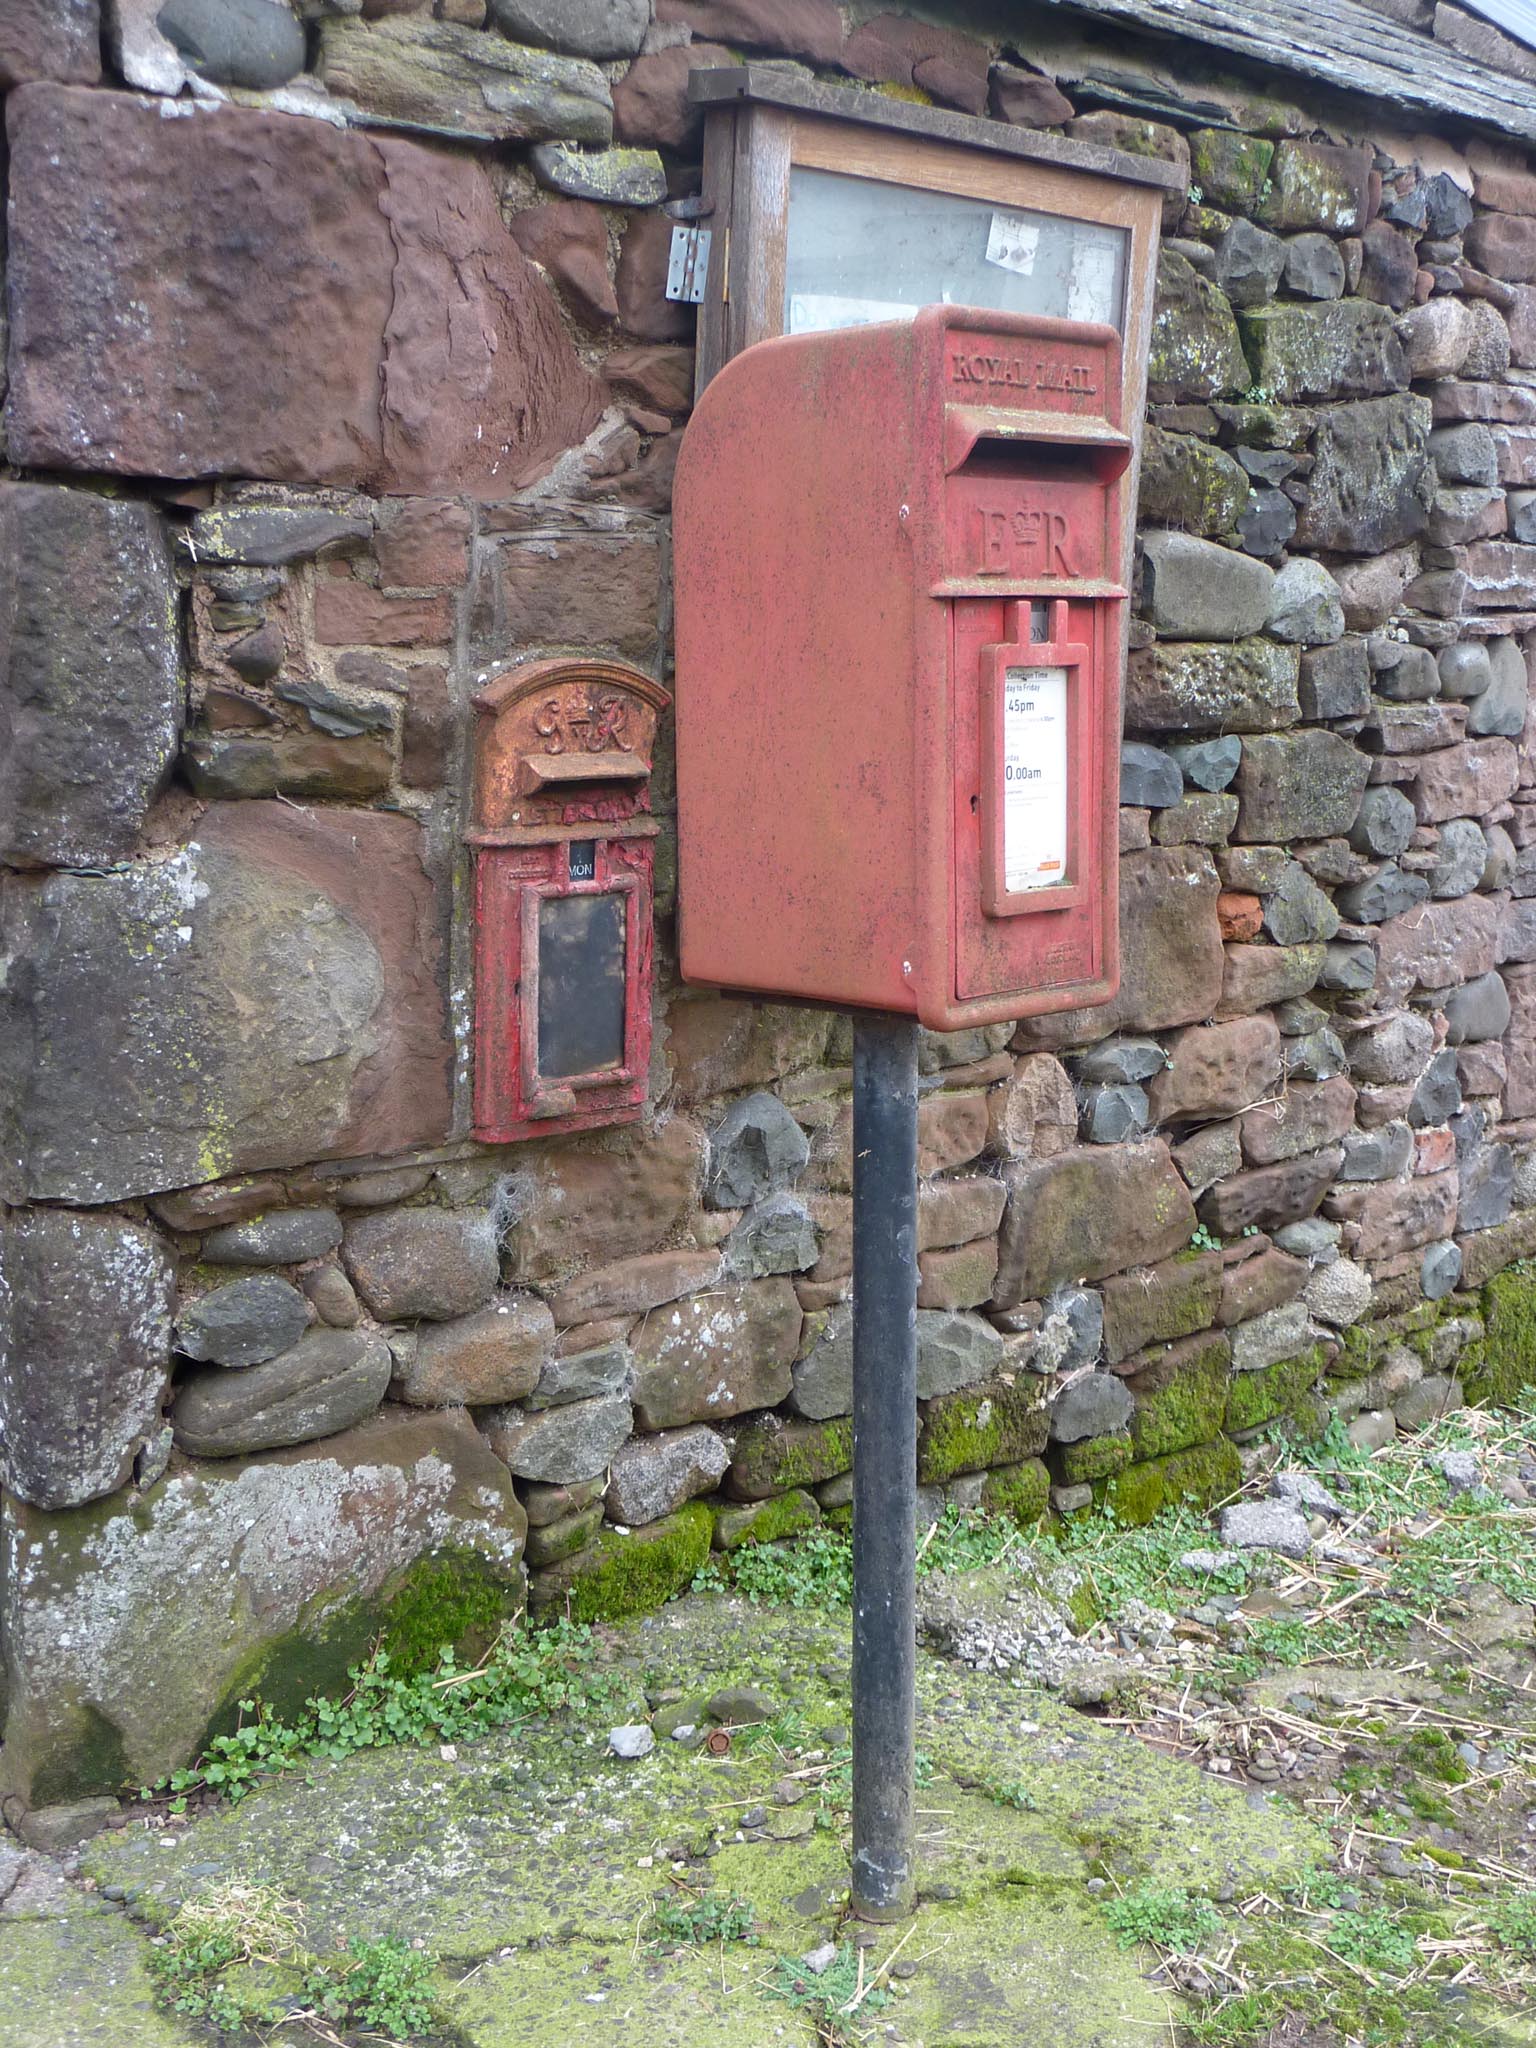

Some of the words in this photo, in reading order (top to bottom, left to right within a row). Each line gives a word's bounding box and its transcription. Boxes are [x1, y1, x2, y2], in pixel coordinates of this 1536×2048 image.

[952, 353, 1029, 388] ROYAL
[1036, 362, 1096, 395] MAIL
[1034, 670, 1048, 679] Time
[1023, 683, 1041, 693] Friday
[569, 863, 592, 877] MON
